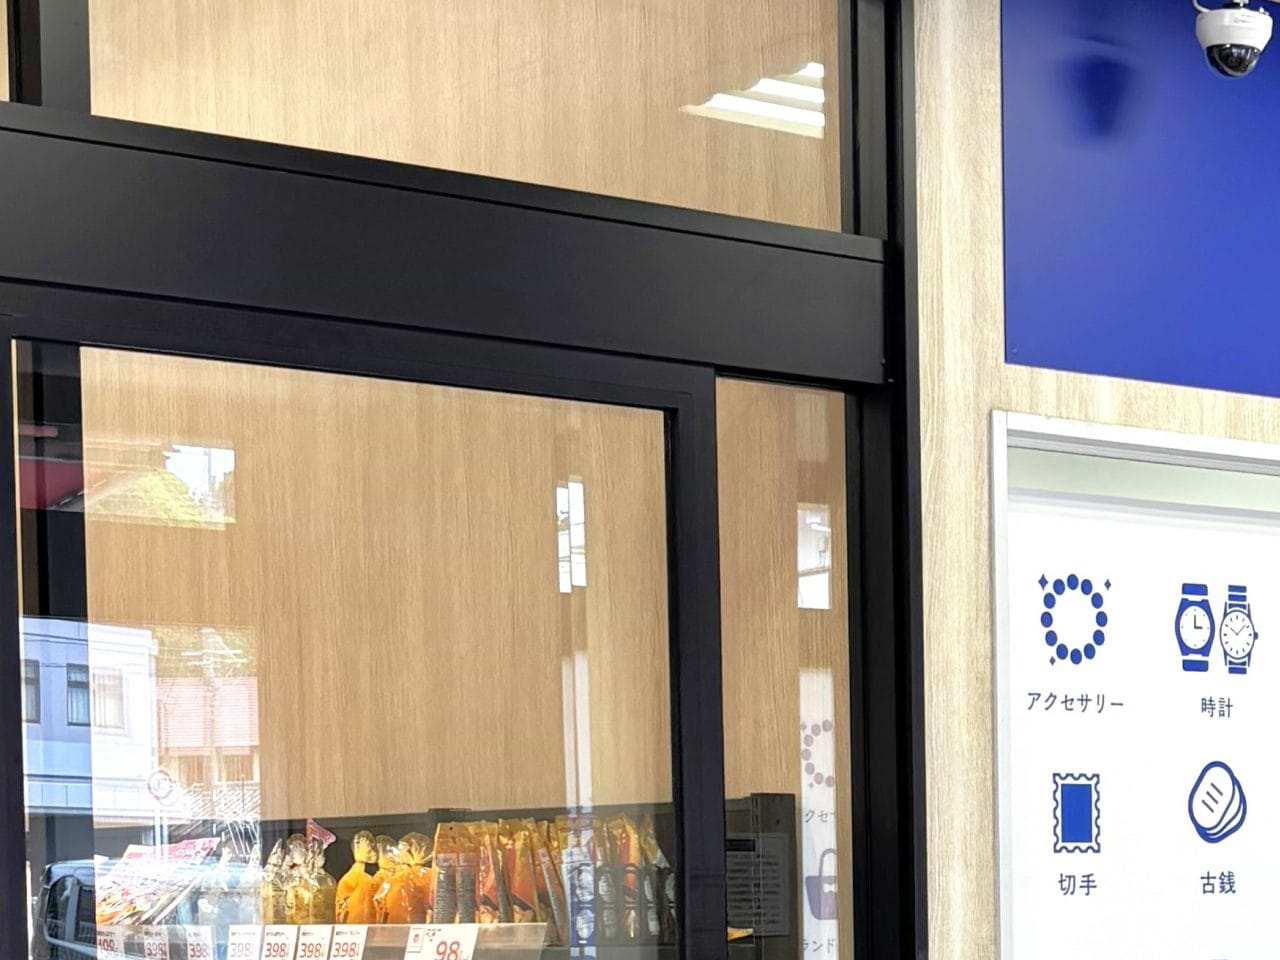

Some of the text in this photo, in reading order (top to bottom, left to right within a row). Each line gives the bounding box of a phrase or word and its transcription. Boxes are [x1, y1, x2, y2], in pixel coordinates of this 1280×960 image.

[1027, 691, 1124, 713] アクセサリー
[1201, 697, 1233, 718] 時計
[1058, 873, 1097, 896] 切手
[1201, 871, 1236, 894] 古銭
[265, 943, 286, 958] 398
[299, 943, 321, 958] 398
[333, 942, 356, 957] 398
